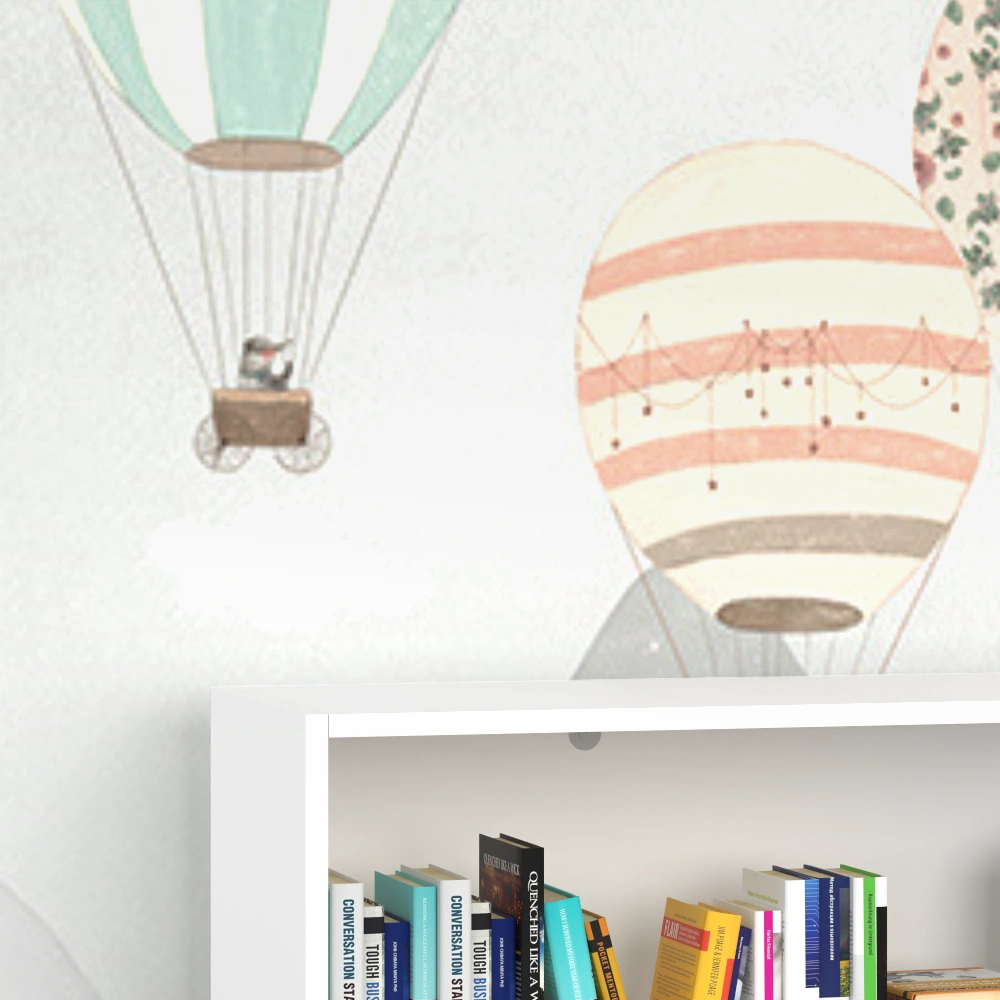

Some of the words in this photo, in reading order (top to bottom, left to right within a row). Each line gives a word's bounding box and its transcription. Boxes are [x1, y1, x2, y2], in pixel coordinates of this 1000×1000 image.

[527, 871, 539, 944] QUENCHED
[559, 908, 567, 921] HOW
[342, 899, 355, 980] CONVERSATION
[451, 895, 463, 976] CONVERSATION
[562, 924, 571, 947] SURVIVED
[716, 925, 726, 934] JIM
[566, 947, 573, 956] MY
[713, 934, 724, 952] POAGE
[366, 944, 380, 979] TOUGH
[473, 940, 487, 975] TOUGH
[529, 947, 539, 974] LIKE
[567, 956, 575, 969] FIRST
[596, 941, 610, 971] POCKET
[709, 956, 721, 979] JENNIFER
[529, 976, 539, 987] A
[707, 979, 718, 996] POAGE
